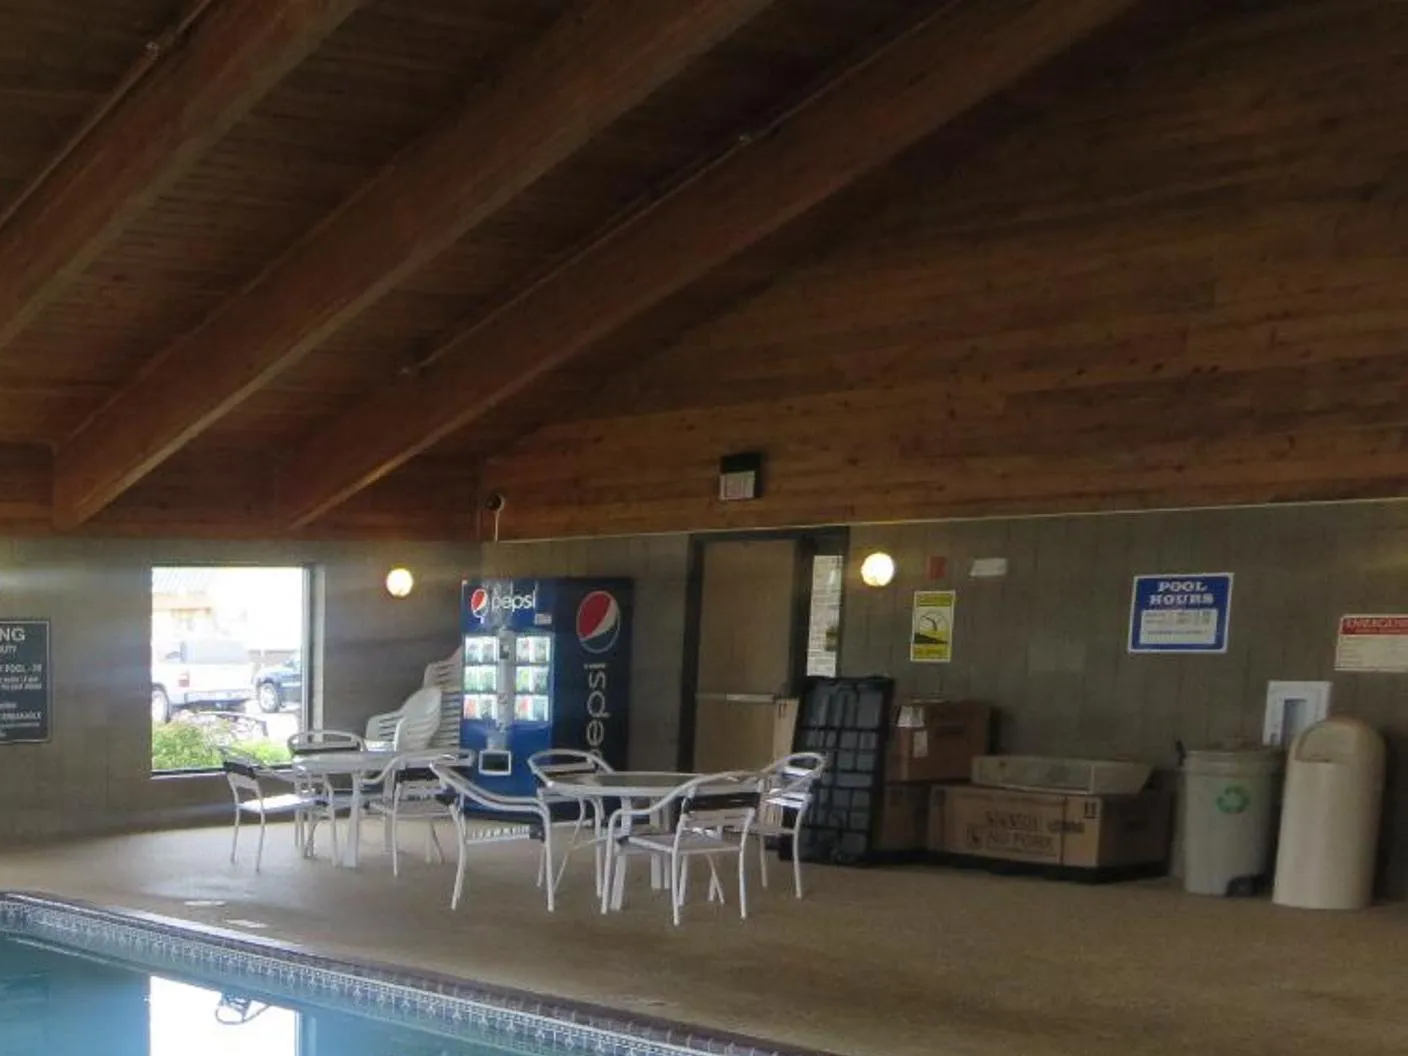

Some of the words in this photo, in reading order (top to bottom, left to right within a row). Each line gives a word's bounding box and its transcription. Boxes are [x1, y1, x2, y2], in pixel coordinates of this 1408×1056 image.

[1158, 581, 1208, 592] POOL
[492, 589, 536, 612] pepsi
[1149, 593, 1214, 605] HOURS
